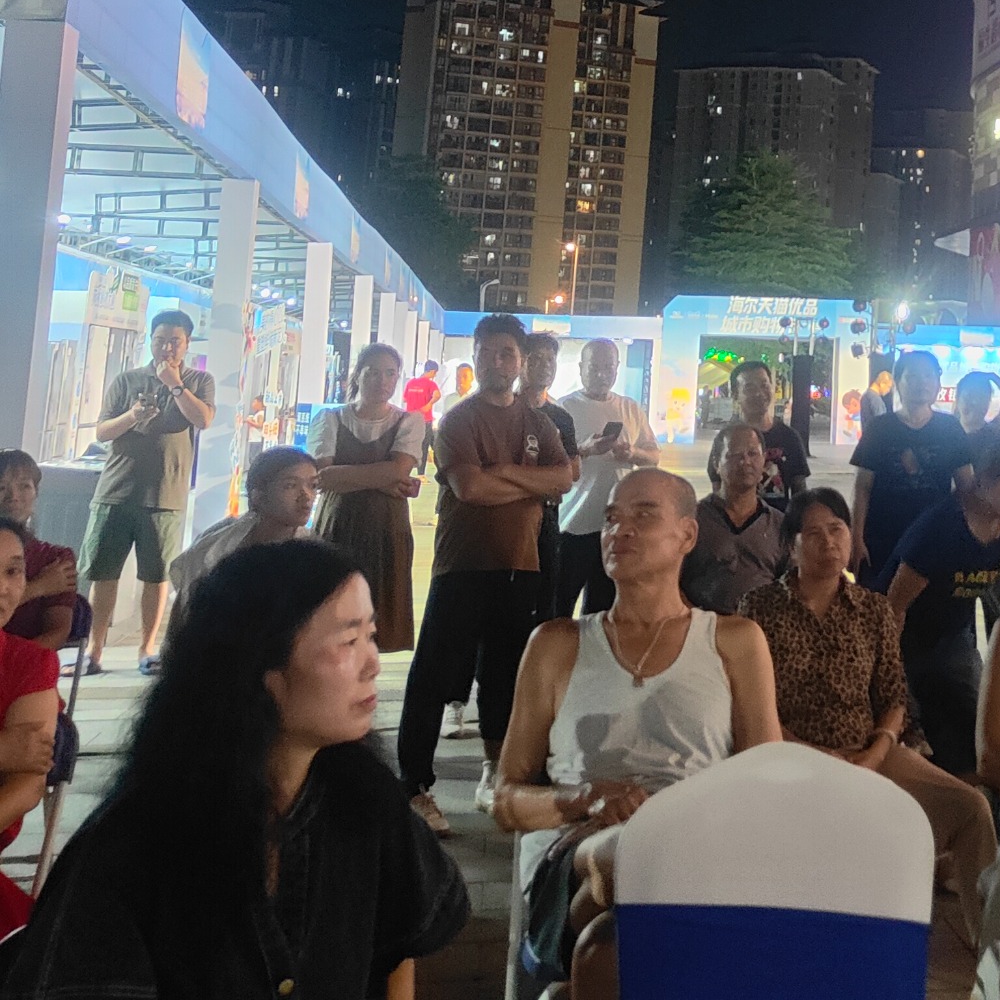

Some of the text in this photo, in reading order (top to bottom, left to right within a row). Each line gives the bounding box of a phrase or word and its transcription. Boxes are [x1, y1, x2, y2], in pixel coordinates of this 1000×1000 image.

[726, 295, 818, 317] 海尔天猫优品
